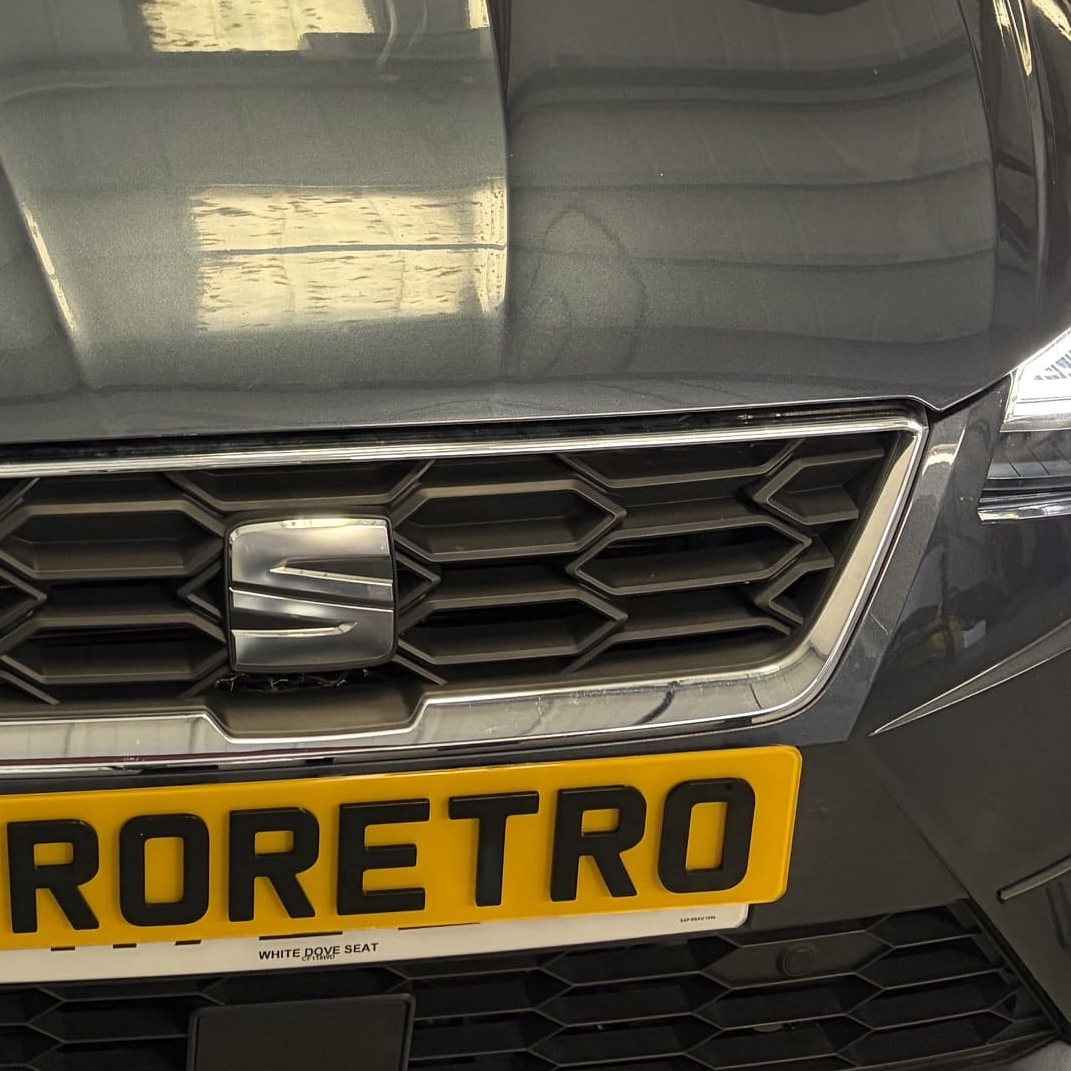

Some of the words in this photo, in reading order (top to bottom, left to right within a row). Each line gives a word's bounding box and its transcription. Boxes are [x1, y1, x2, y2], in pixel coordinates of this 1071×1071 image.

[258, 948, 301, 960] WHITE
[304, 945, 341, 958] DOVE
[344, 942, 379, 954] SEAT
